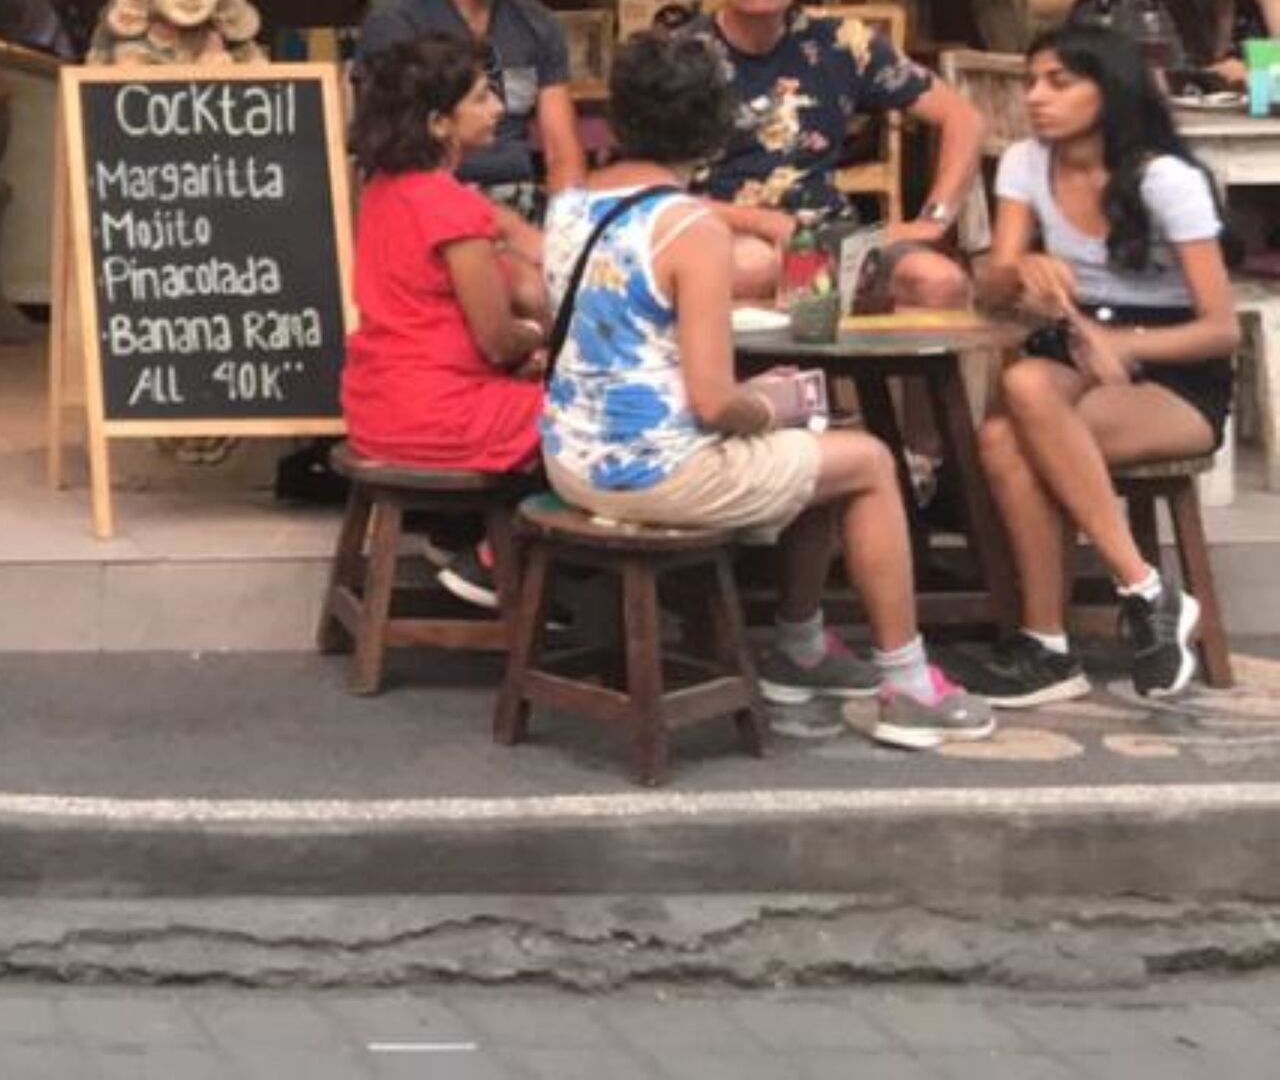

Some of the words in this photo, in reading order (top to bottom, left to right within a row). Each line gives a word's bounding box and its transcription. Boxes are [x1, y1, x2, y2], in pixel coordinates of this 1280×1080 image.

[95, 152, 285, 201] Margaritta
[101, 209, 212, 251] Mojito
[102, 255, 282, 302] Pinacolada
[108, 312, 232, 355] Banana
